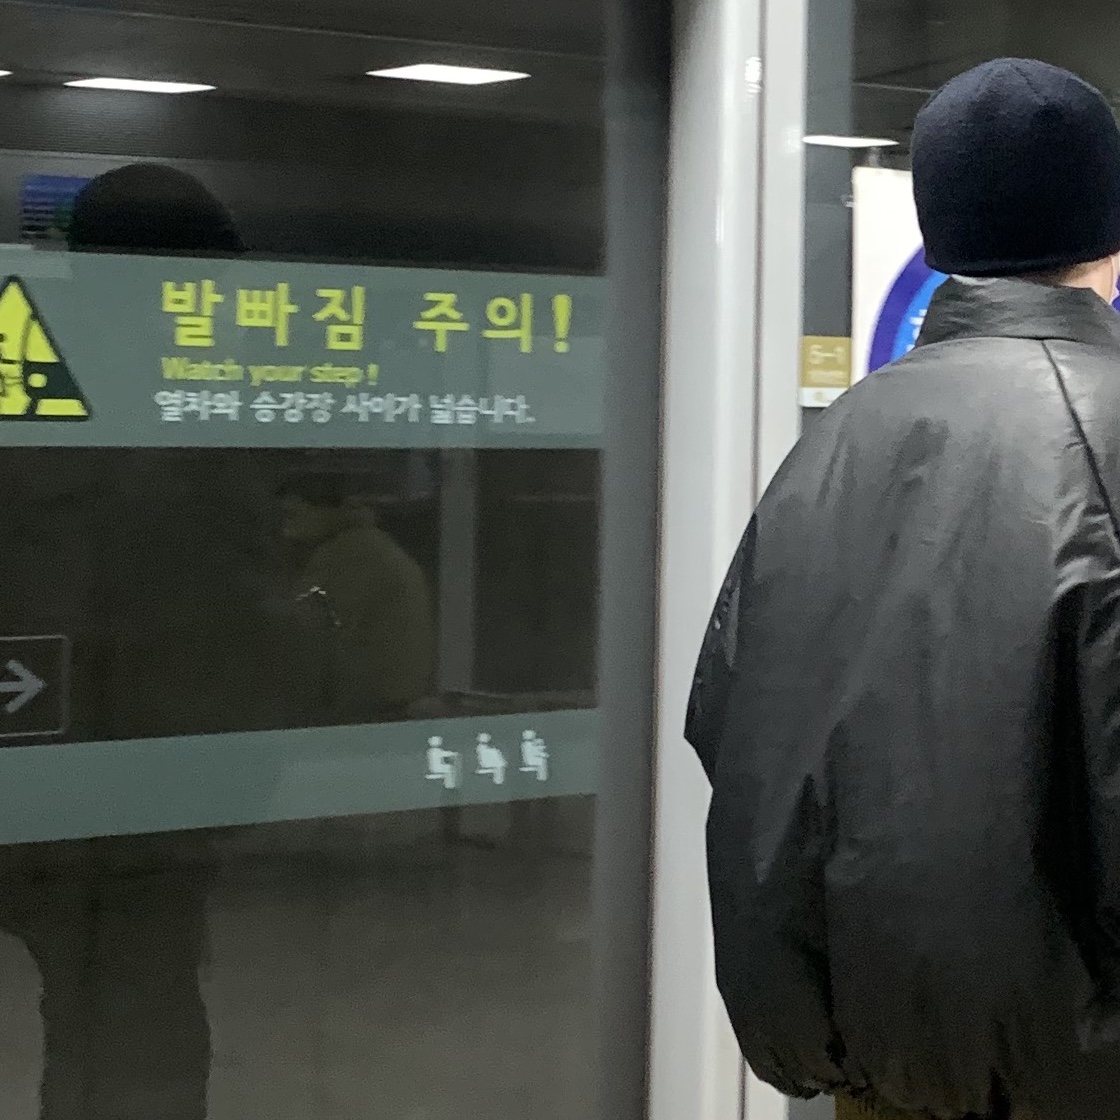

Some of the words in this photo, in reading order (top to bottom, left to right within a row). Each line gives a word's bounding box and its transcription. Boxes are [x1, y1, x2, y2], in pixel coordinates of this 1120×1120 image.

[162, 279, 365, 350] 발빠짐
[412, 292, 573, 353] 주의!
[161, 357, 244, 380] Watch
[248, 365, 307, 386] your
[154, 390, 243, 422] 열차와
[250, 391, 336, 424] 승강장
[340, 392, 422, 423] 사이가
